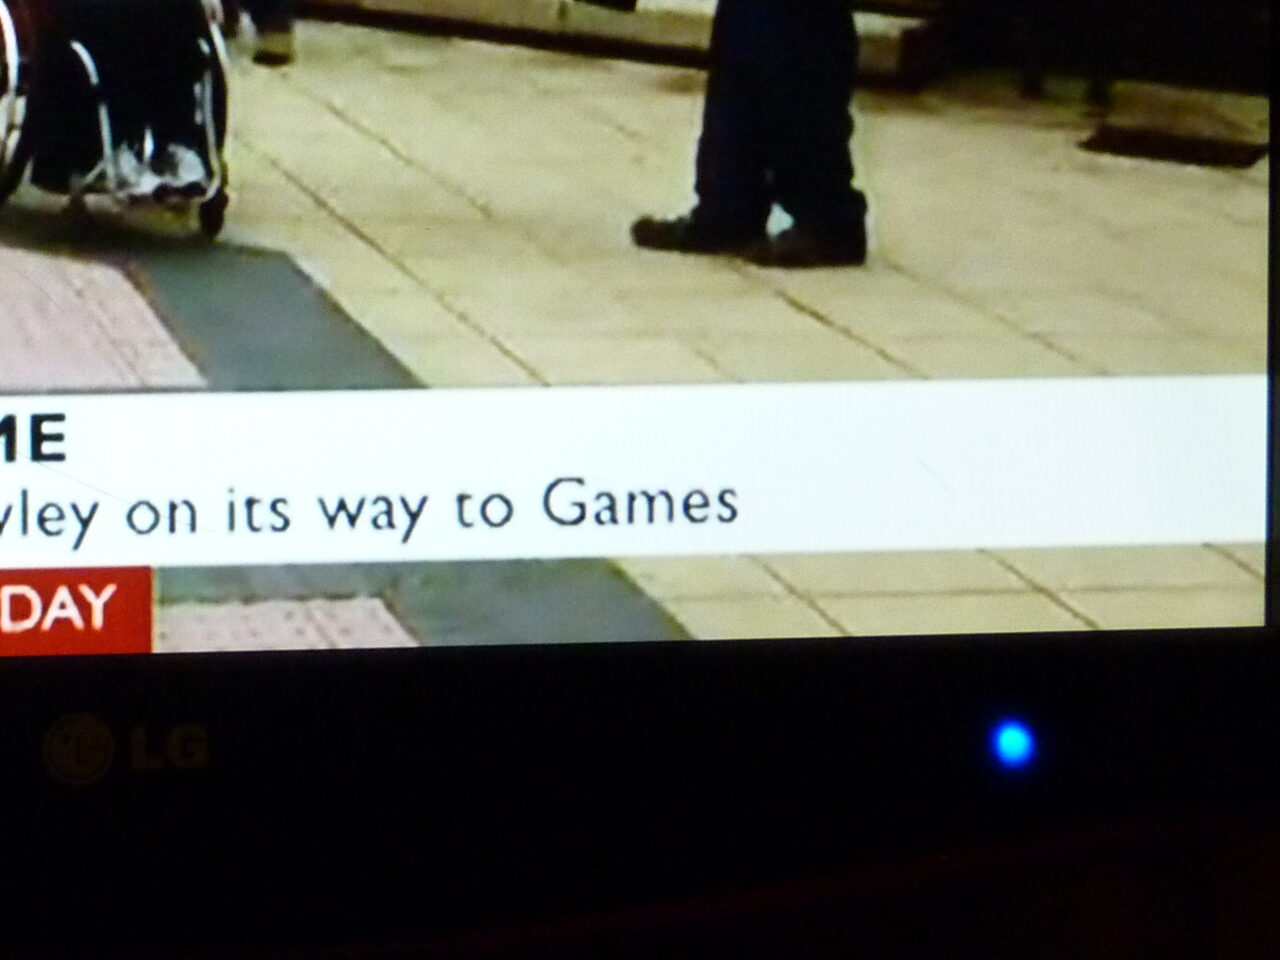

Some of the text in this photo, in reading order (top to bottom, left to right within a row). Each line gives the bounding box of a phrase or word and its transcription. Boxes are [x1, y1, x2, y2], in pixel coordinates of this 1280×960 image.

[126, 499, 197, 536] on
[226, 487, 291, 533] its
[318, 493, 429, 544] way
[455, 491, 514, 529] to
[543, 476, 739, 527] Games
[130, 725, 211, 772] LG
